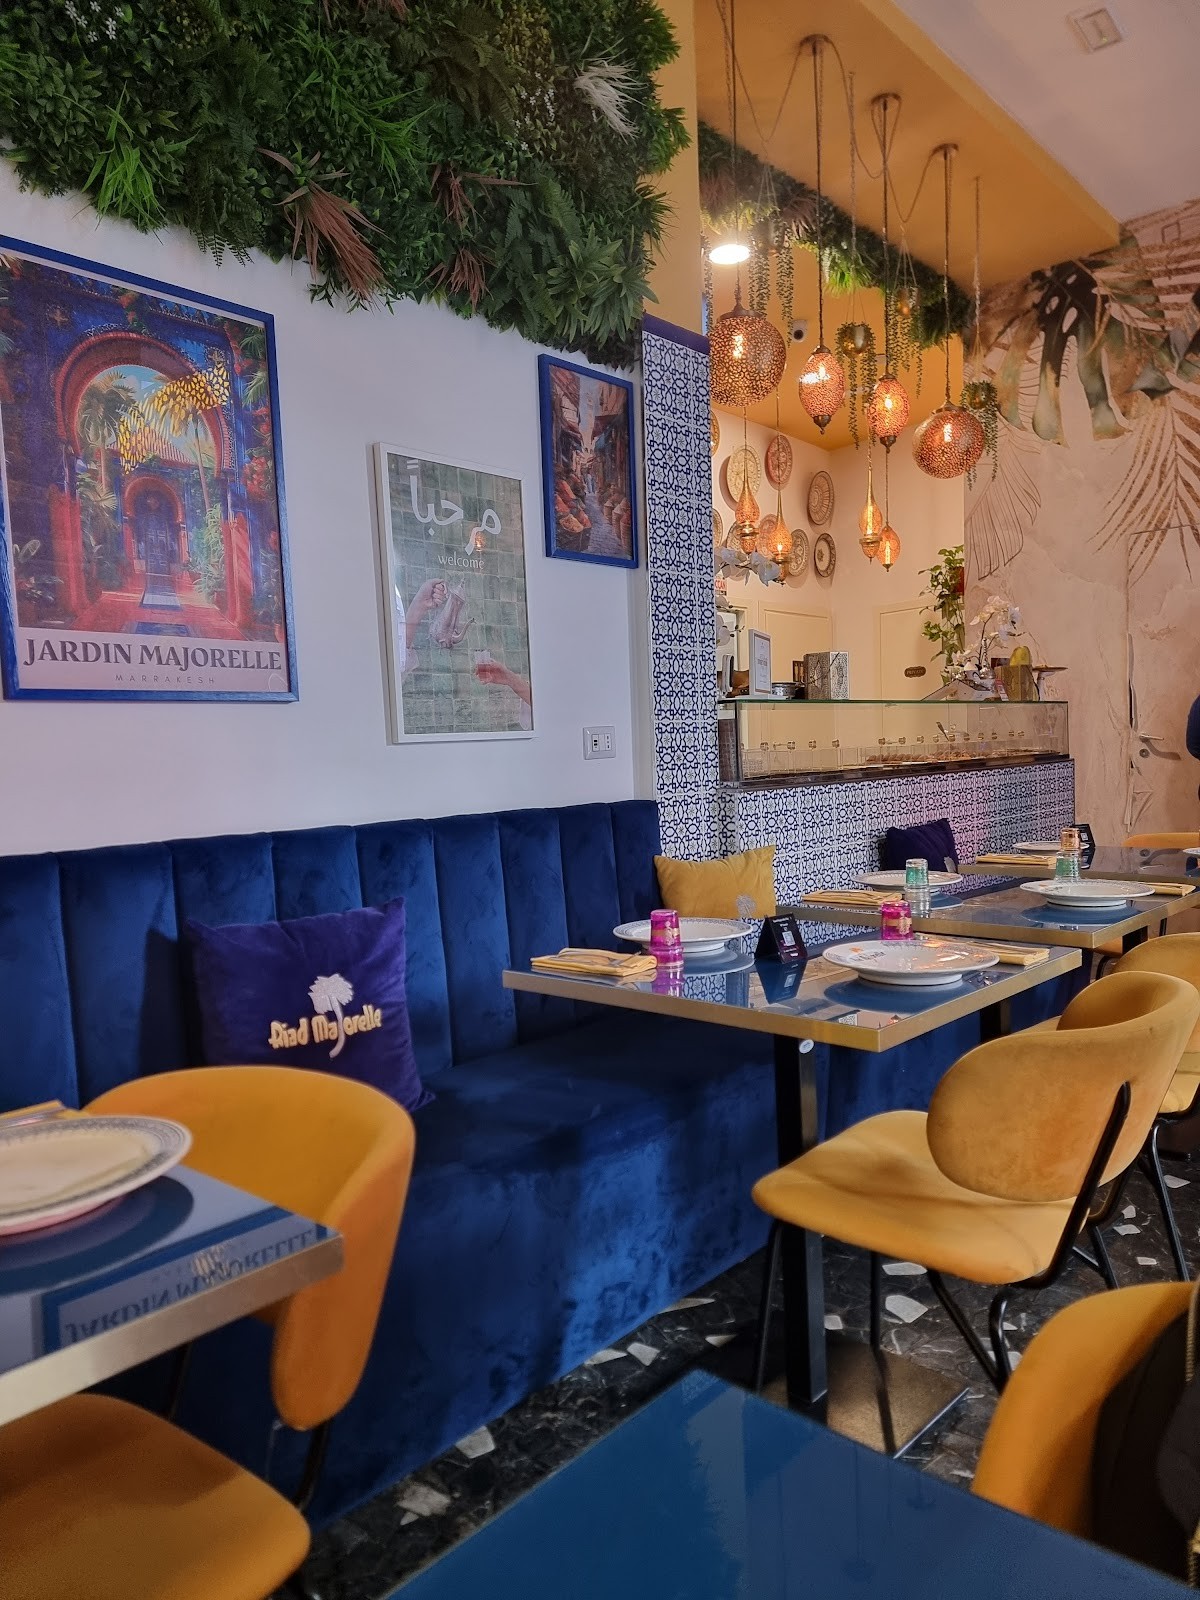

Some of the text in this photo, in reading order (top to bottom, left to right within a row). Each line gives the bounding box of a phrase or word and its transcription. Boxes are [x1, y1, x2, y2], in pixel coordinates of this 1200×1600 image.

[438, 553, 485, 570] welcome
[23, 638, 282, 672] JARDIN MAJORELLE
[115, 674, 215, 684] MARRAKESH
[268, 1004, 382, 1058] Riad Majorelle
